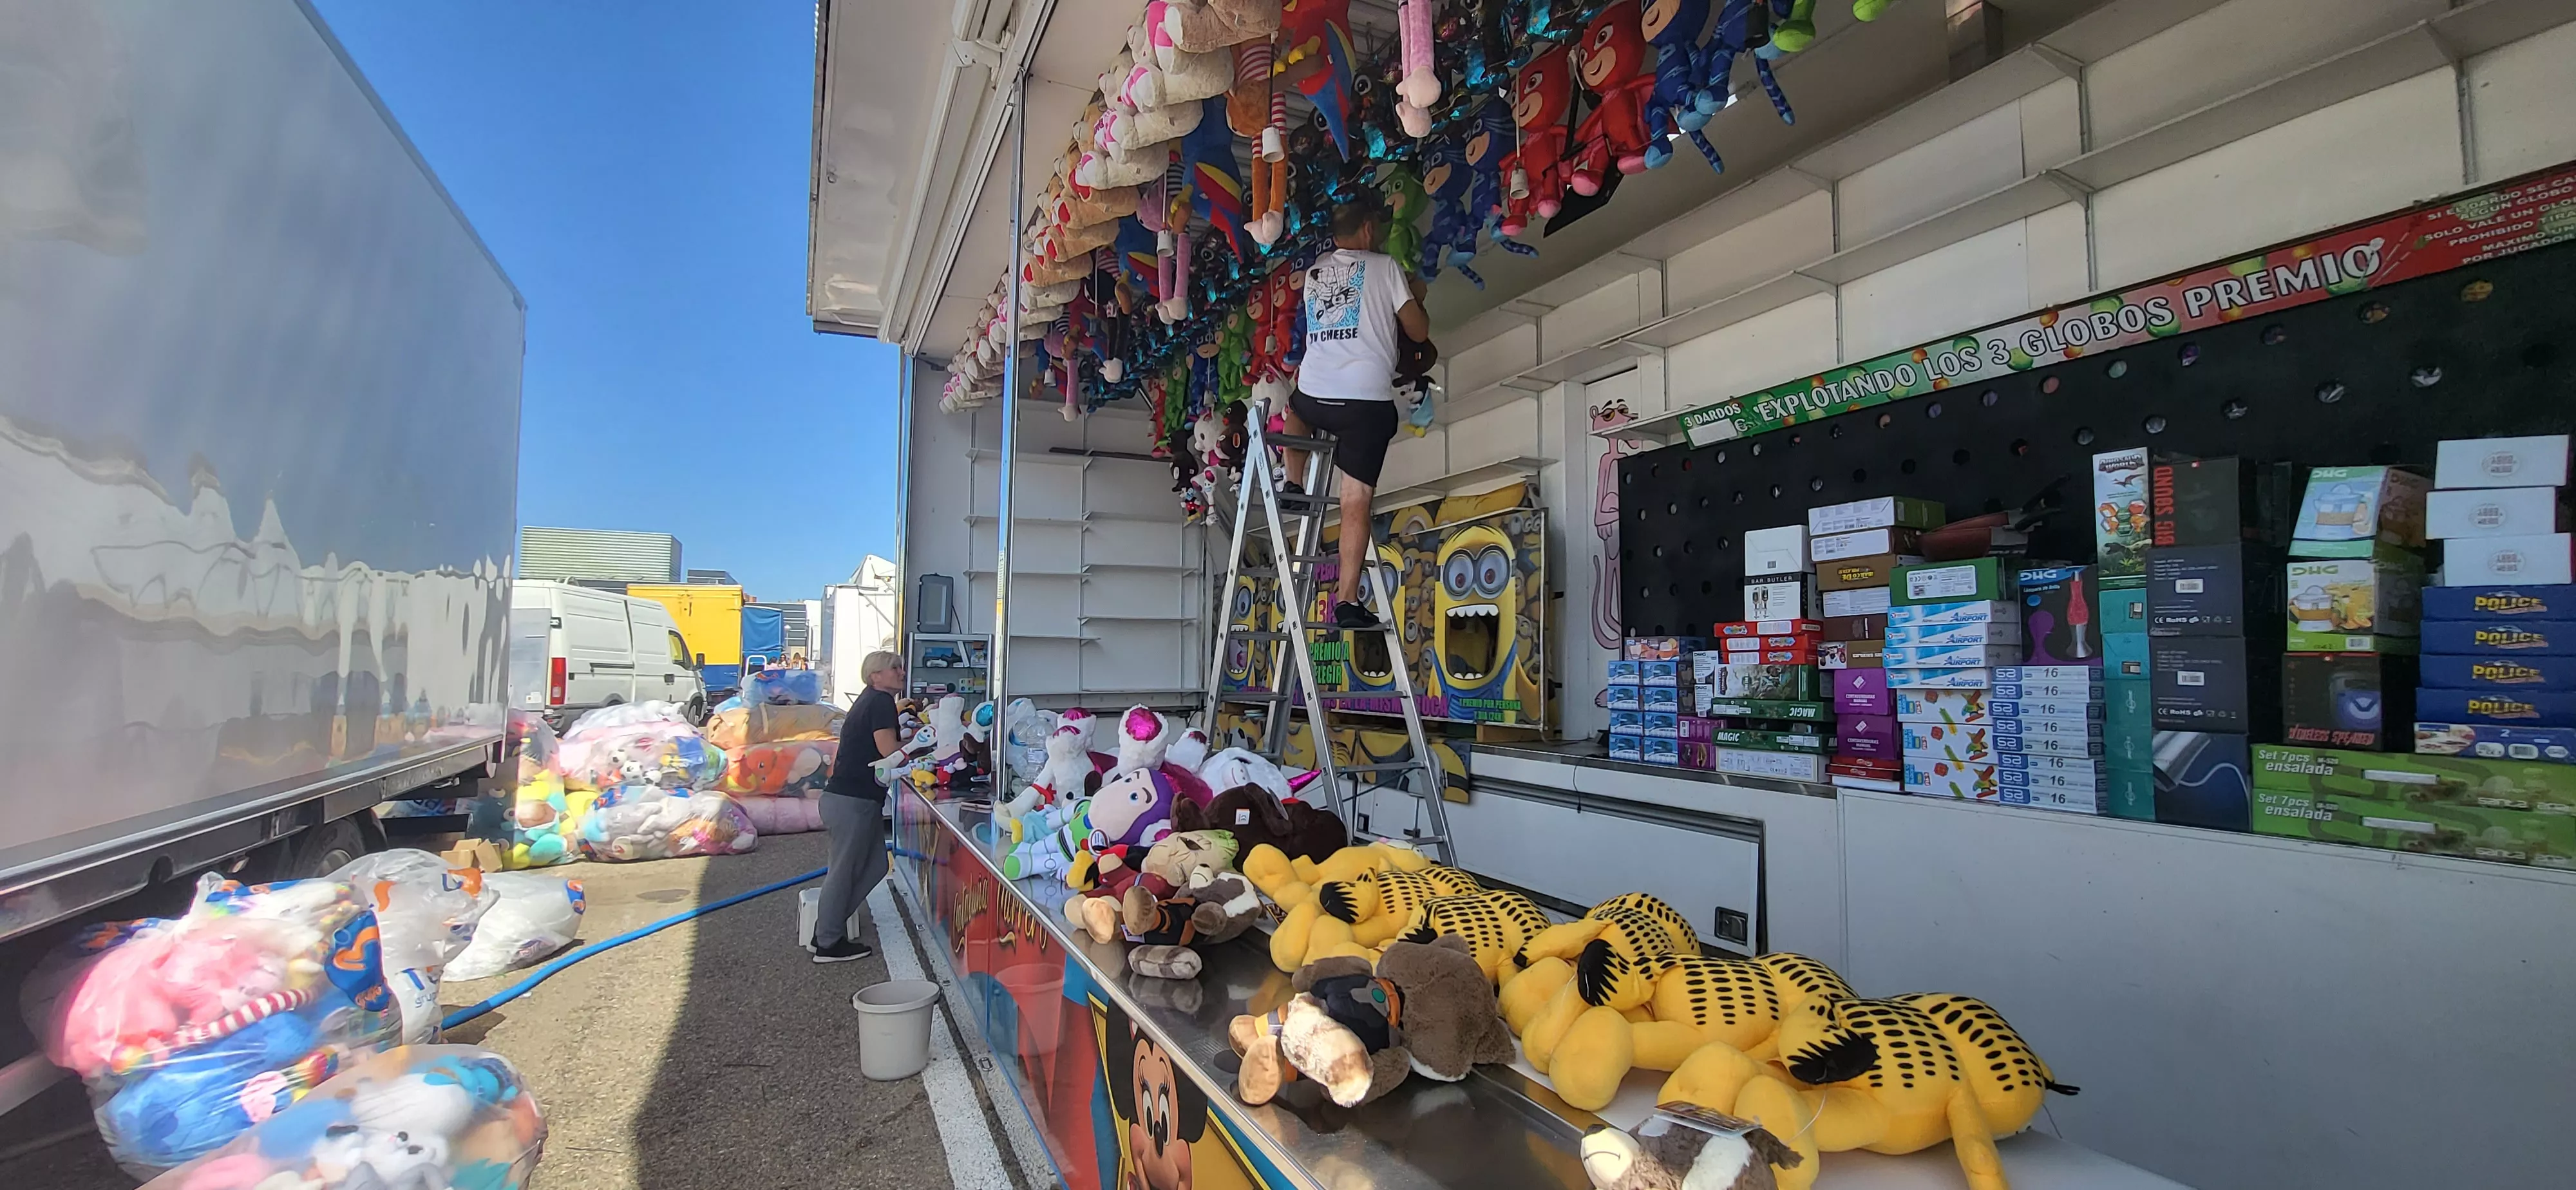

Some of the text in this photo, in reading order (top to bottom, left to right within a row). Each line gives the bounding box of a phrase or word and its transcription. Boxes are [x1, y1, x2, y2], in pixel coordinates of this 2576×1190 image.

[2446, 206, 2463, 215] EL
[2469, 191, 2521, 209] DARDO
[2526, 184, 2547, 193] SE
[2460, 186, 2573, 220] ALGUN GLOBO
[2425, 226, 2463, 240] SOLO
[2467, 215, 2506, 229] VALE
[2510, 208, 2533, 219] UN
[2449, 221, 2533, 247] PROHIBIDO
[2481, 231, 2545, 252] MAXIMO
[2462, 252, 2494, 265] POR
[1320, 328, 1358, 342] CHEESE
[1758, 243, 2382, 422] EXPLOTANDO LOS 3 GLOBOS PREMIO
[1683, 403, 1741, 428] 3 DARDOS
[2154, 466, 2175, 545] BIG SOUND
[2474, 596, 2543, 610] POLICE
[1949, 612, 1988, 623] AIRPORT
[1946, 634, 1984, 643] AIRPORT
[2475, 630, 2544, 645] POLICE
[1310, 641, 1342, 662] PREMIO
[1944, 656, 1982, 665] AIRPORT
[2044, 668, 2058, 677] 16
[2472, 665, 2541, 679] POLICE
[1946, 677, 1984, 687] AIRPORT
[2044, 686, 2058, 695] 16
[1370, 697, 1403, 713] MISM
[2040, 704, 2055, 714] 16
[2468, 700, 2535, 714] POLICE
[1789, 707, 1815, 717] MAGIC
[2043, 722, 2058, 732] 16
[1717, 732, 1739, 742] MAGIC
[2043, 740, 2058, 750] 16
[2259, 750, 2277, 759] Set
[2282, 752, 2310, 762] 7pcs
[2049, 758, 2063, 768] 16
[2266, 762, 2334, 775] ensalada
[2050, 776, 2065, 786] 16
[2050, 793, 2065, 804] 16
[2258, 793, 2277, 804] Set
[2282, 796, 2309, 807] 7pcs
[2265, 806, 2333, 820] ensalada
